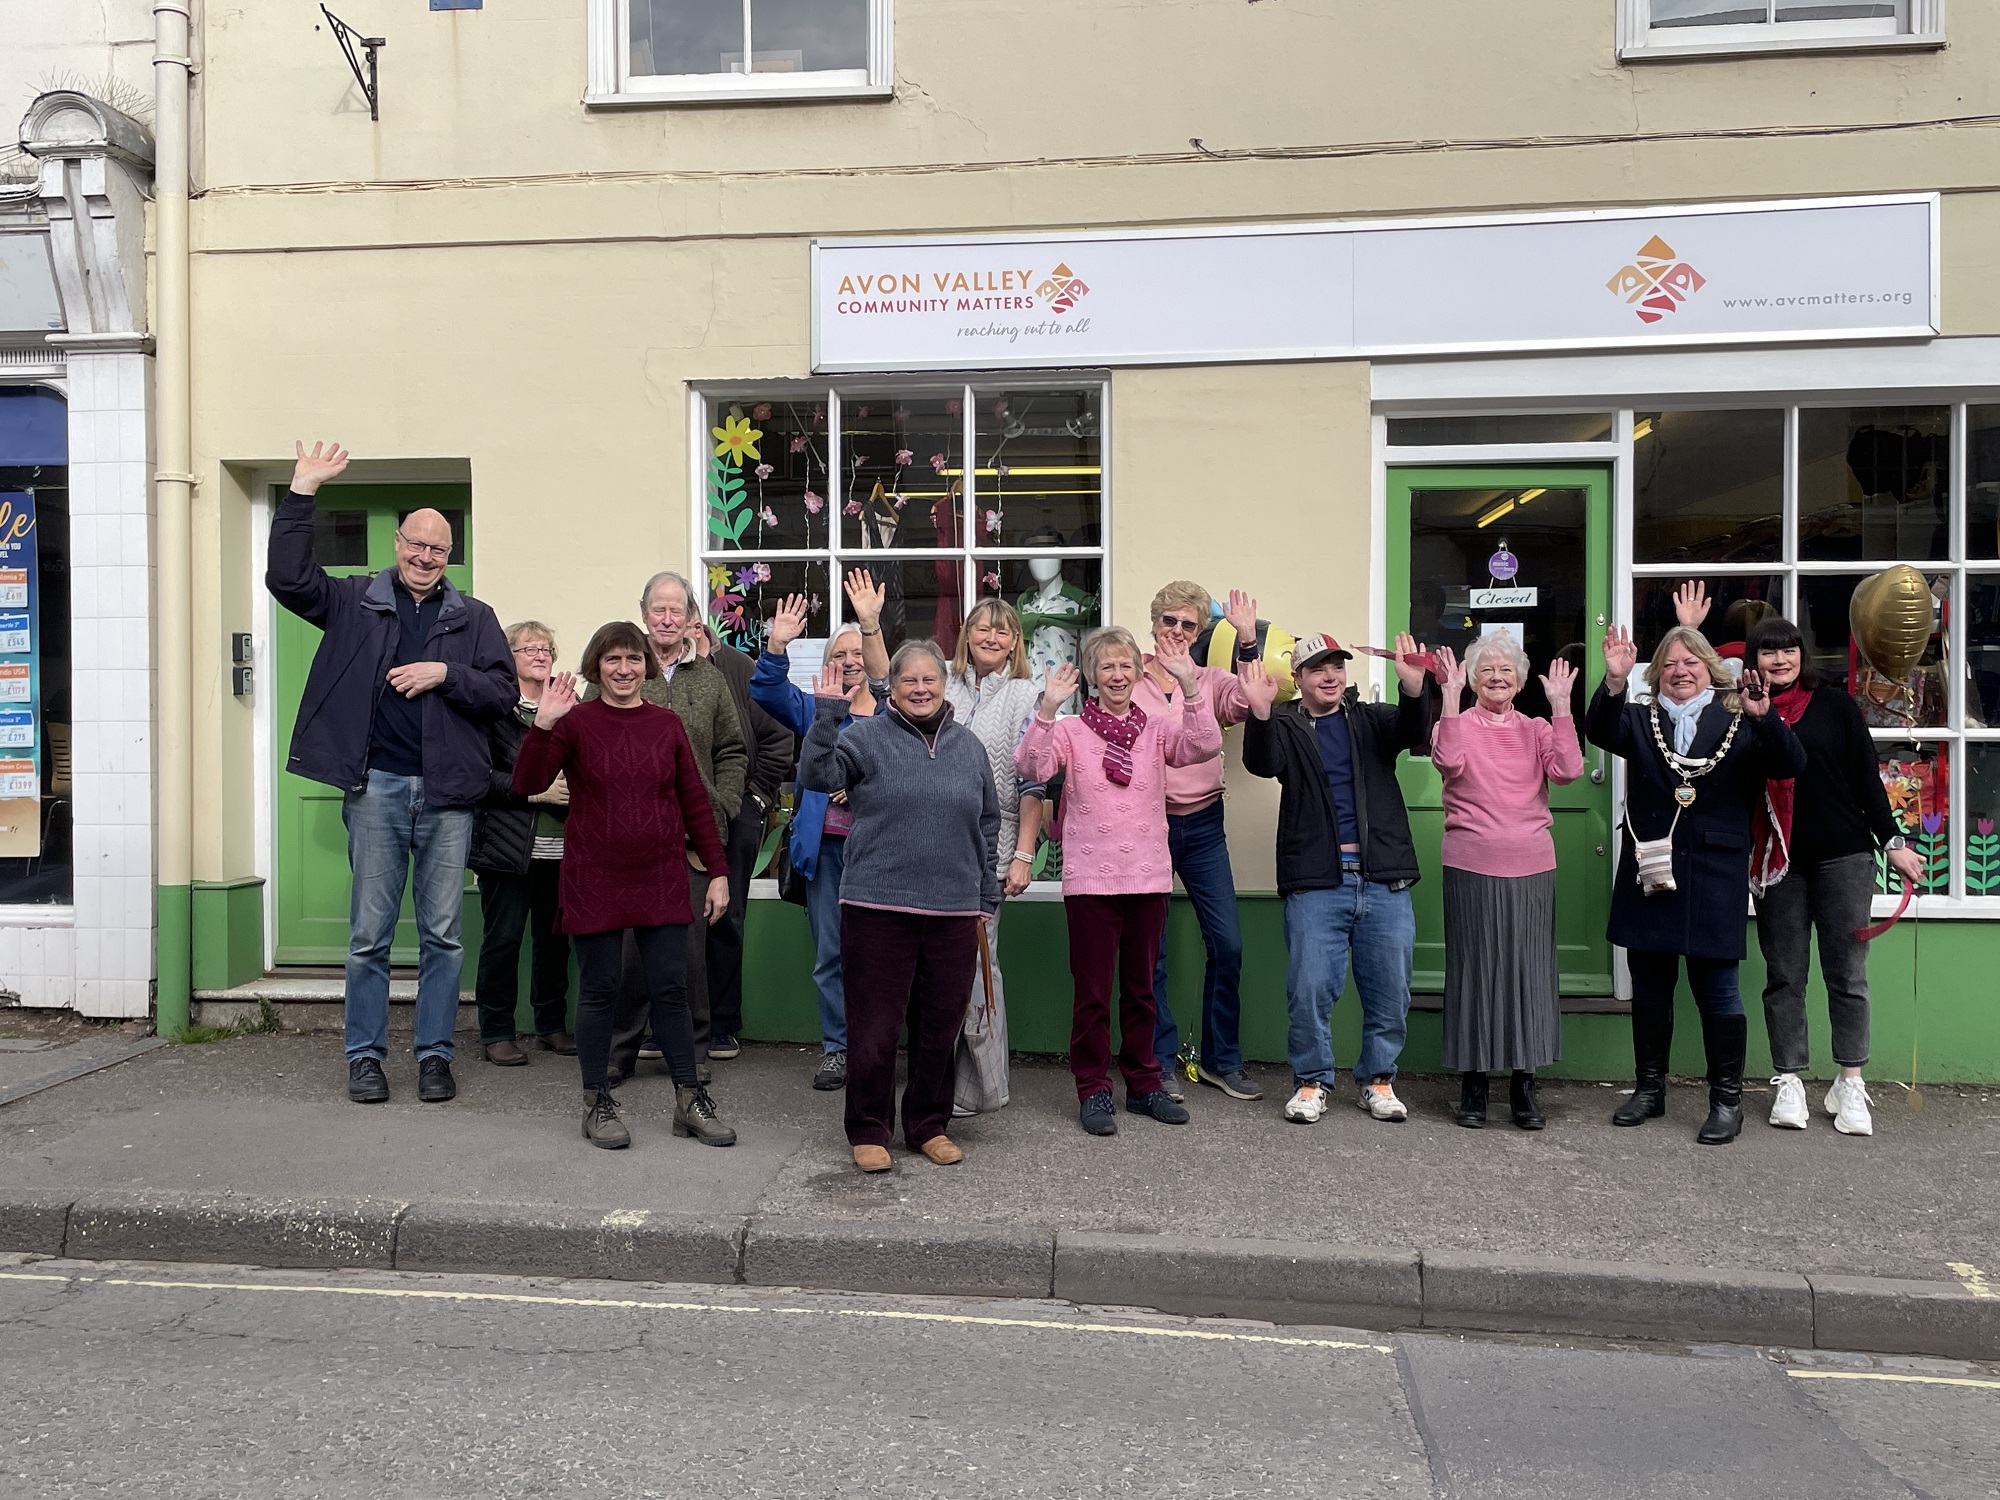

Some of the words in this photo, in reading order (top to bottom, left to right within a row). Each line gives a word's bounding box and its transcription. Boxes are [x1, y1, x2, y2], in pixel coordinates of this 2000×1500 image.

[838, 273, 921, 295] AVON
[932, 270, 1034, 293] VALLEY
[837, 299, 950, 315] COMMUNITY
[956, 296, 1035, 312] MATTERS
[1723, 292, 1913, 308] www.avcmatters.org
[956, 322, 1021, 344] reaching
[1024, 321, 1047, 336] out
[1048, 320, 1062, 336] to
[1065, 317, 1091, 334] all
[0, 501, 36, 546] le
[1476, 591, 1532, 605] Closed
